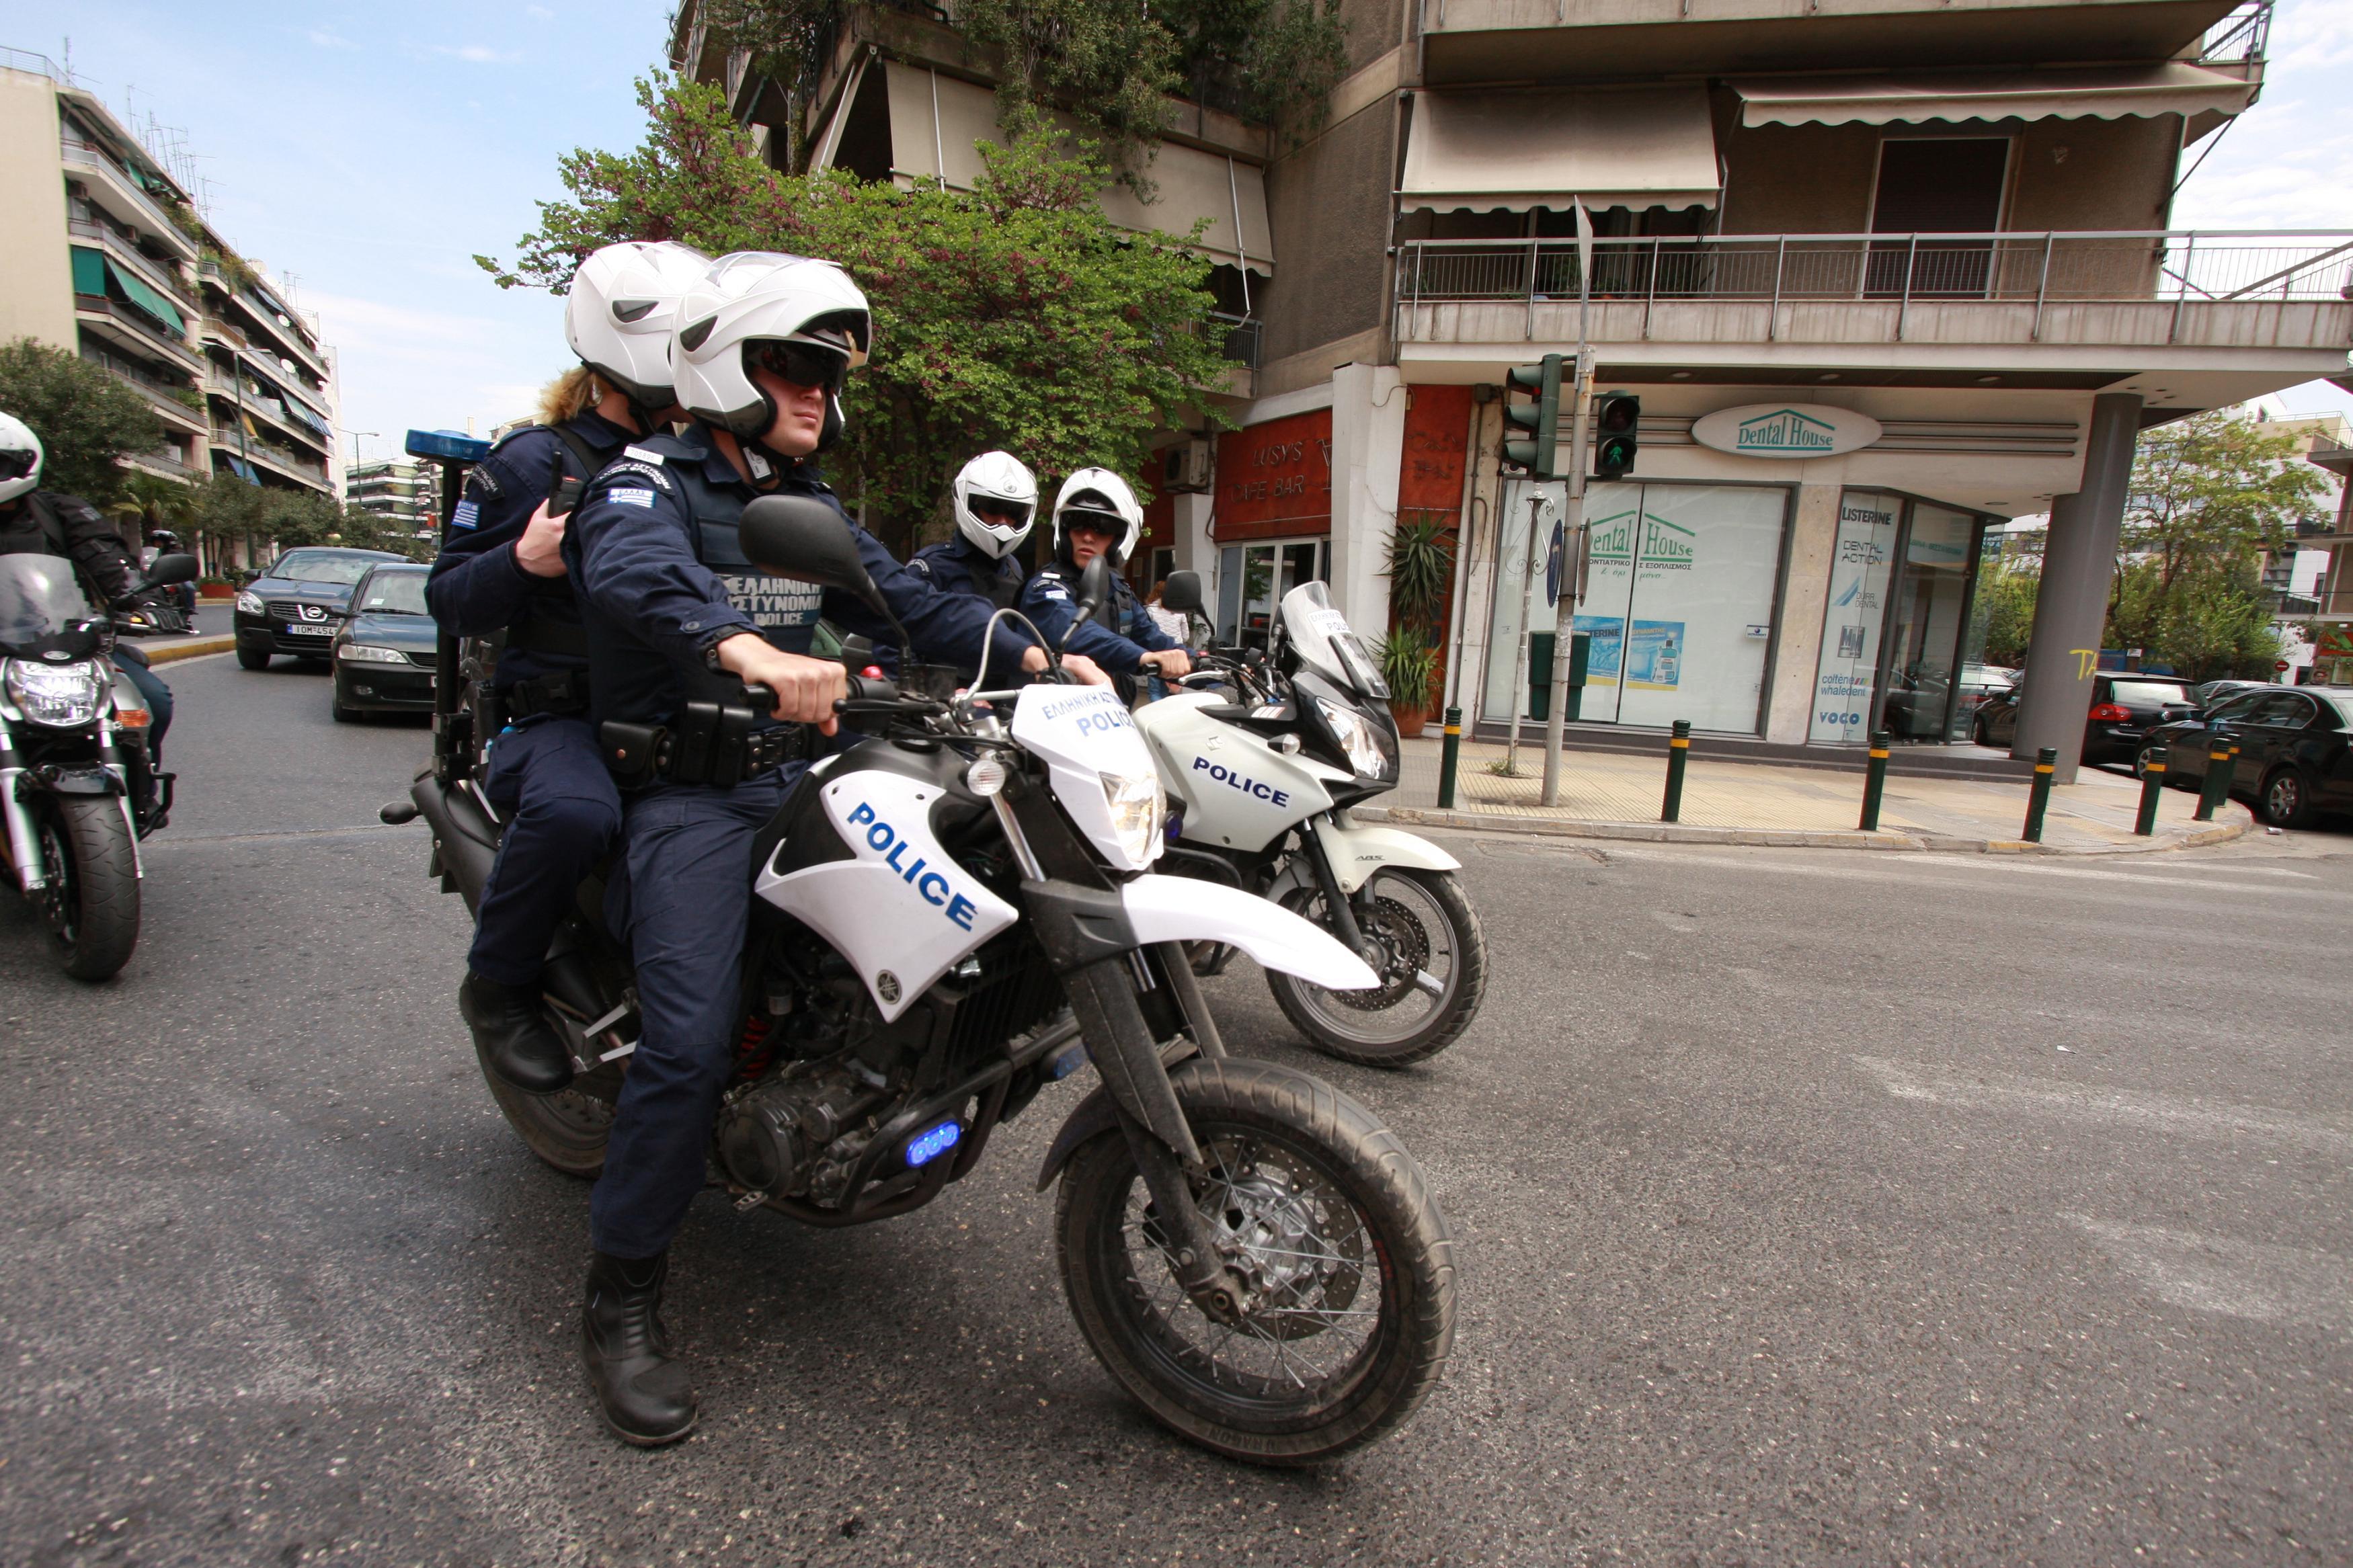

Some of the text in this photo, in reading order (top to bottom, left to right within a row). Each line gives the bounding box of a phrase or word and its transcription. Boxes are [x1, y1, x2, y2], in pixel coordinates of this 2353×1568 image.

[1737, 416, 1833, 446] Dental House
[1274, 475, 1304, 496] BAR
[1842, 507, 1892, 525] LISTERINE
[1591, 519, 1693, 556] ental House
[1843, 540, 1883, 553] DENTAL
[1841, 554, 1882, 565] ACTION
[754, 612, 803, 626] POLICE
[296, 626, 337, 635] IOM-454
[1585, 629, 1620, 637] TERINE
[1821, 686, 1866, 696] whaledent
[1076, 710, 1135, 737] POLIC
[1193, 757, 1290, 808] POLICE
[847, 802, 978, 932] POLICE
